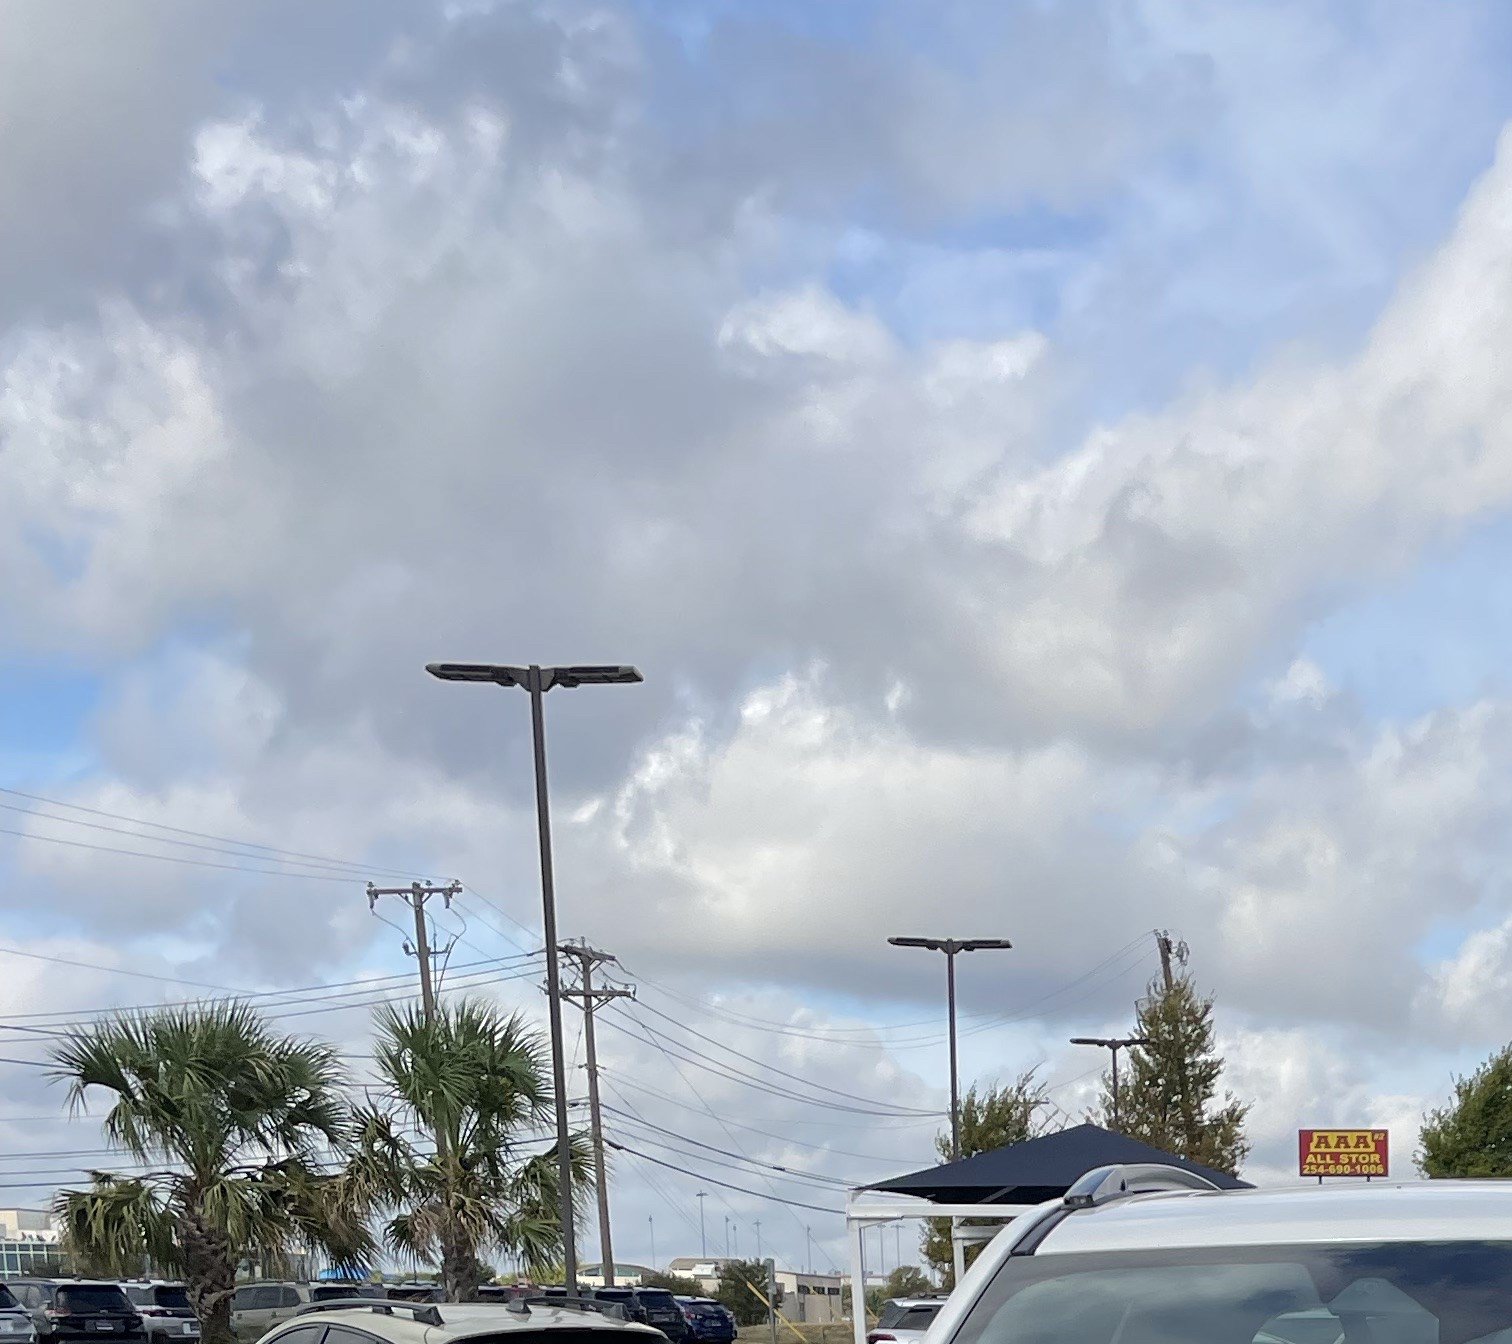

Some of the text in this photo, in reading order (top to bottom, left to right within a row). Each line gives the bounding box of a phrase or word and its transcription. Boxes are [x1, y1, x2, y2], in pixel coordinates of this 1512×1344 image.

[1314, 1135, 1371, 1149] AAA
[1306, 1153, 1381, 1164] ALL STOR
[1302, 1164, 1385, 1175] 254-690-1006
